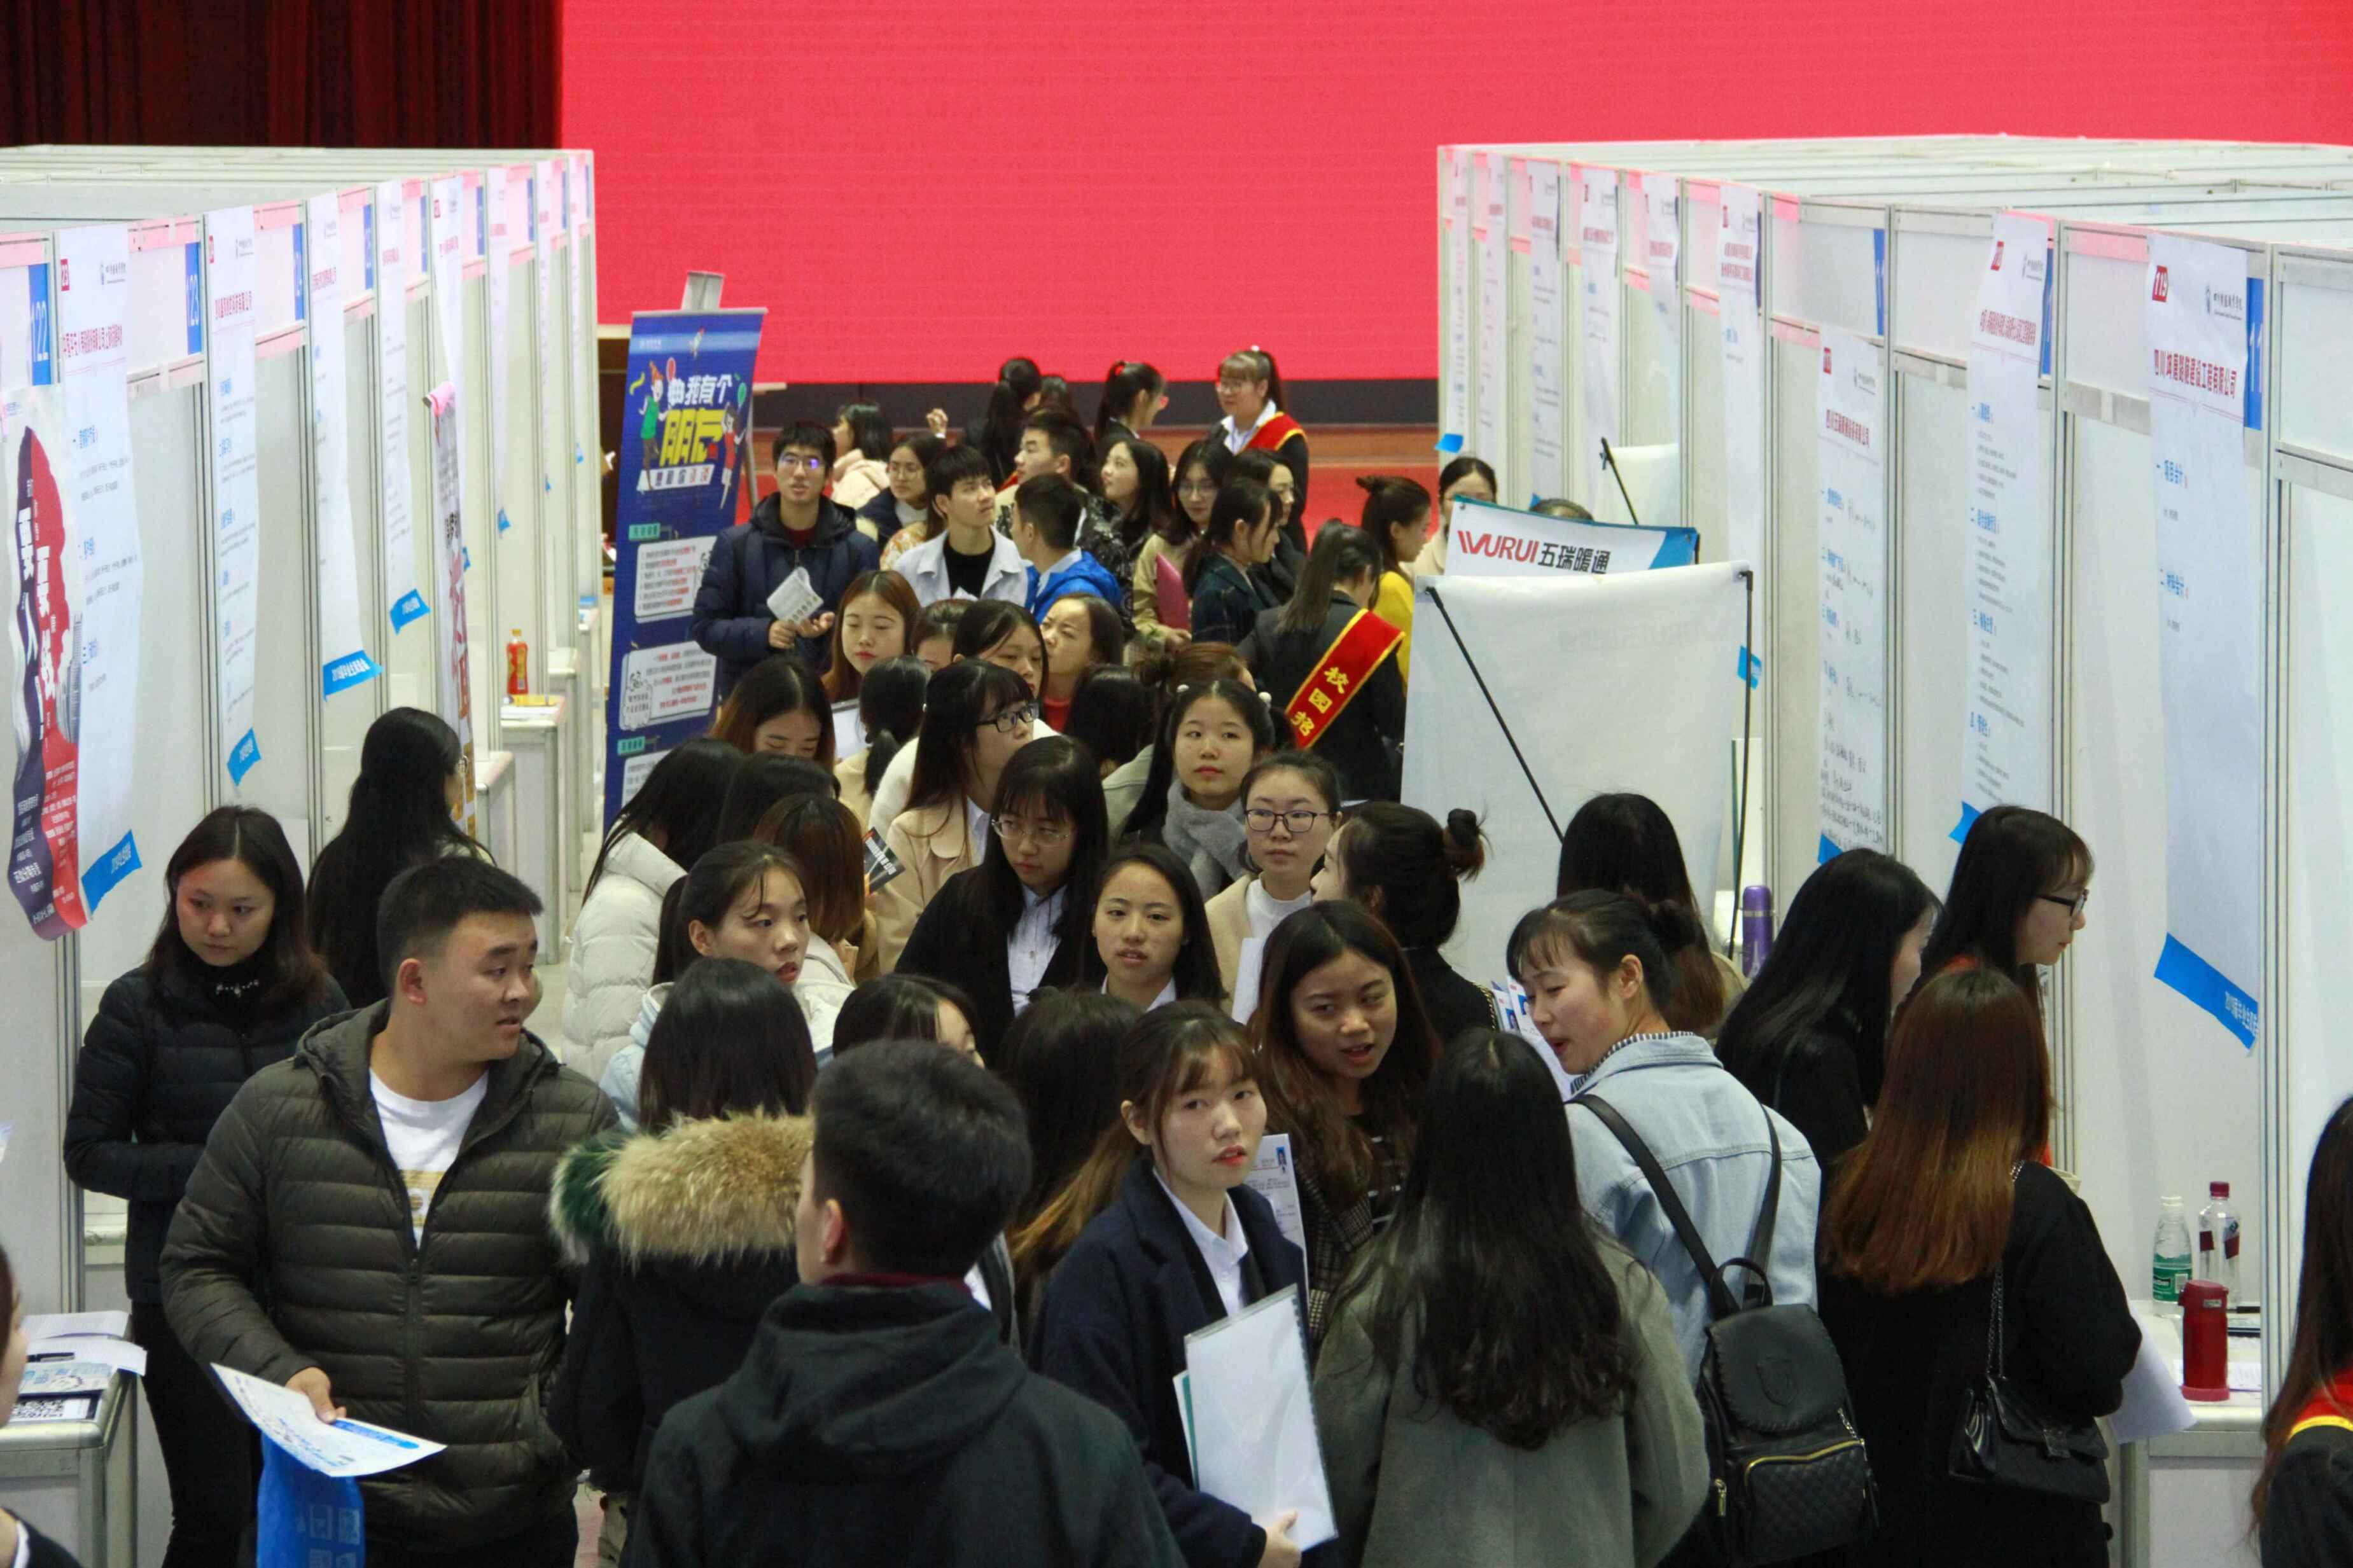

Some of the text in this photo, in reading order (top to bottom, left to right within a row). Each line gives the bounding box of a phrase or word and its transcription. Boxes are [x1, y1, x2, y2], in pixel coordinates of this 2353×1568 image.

[31, 301, 50, 363] 122
[1458, 530, 1611, 574] WURUI 五瑞暖通
[1290, 667, 1350, 737] 校园招
